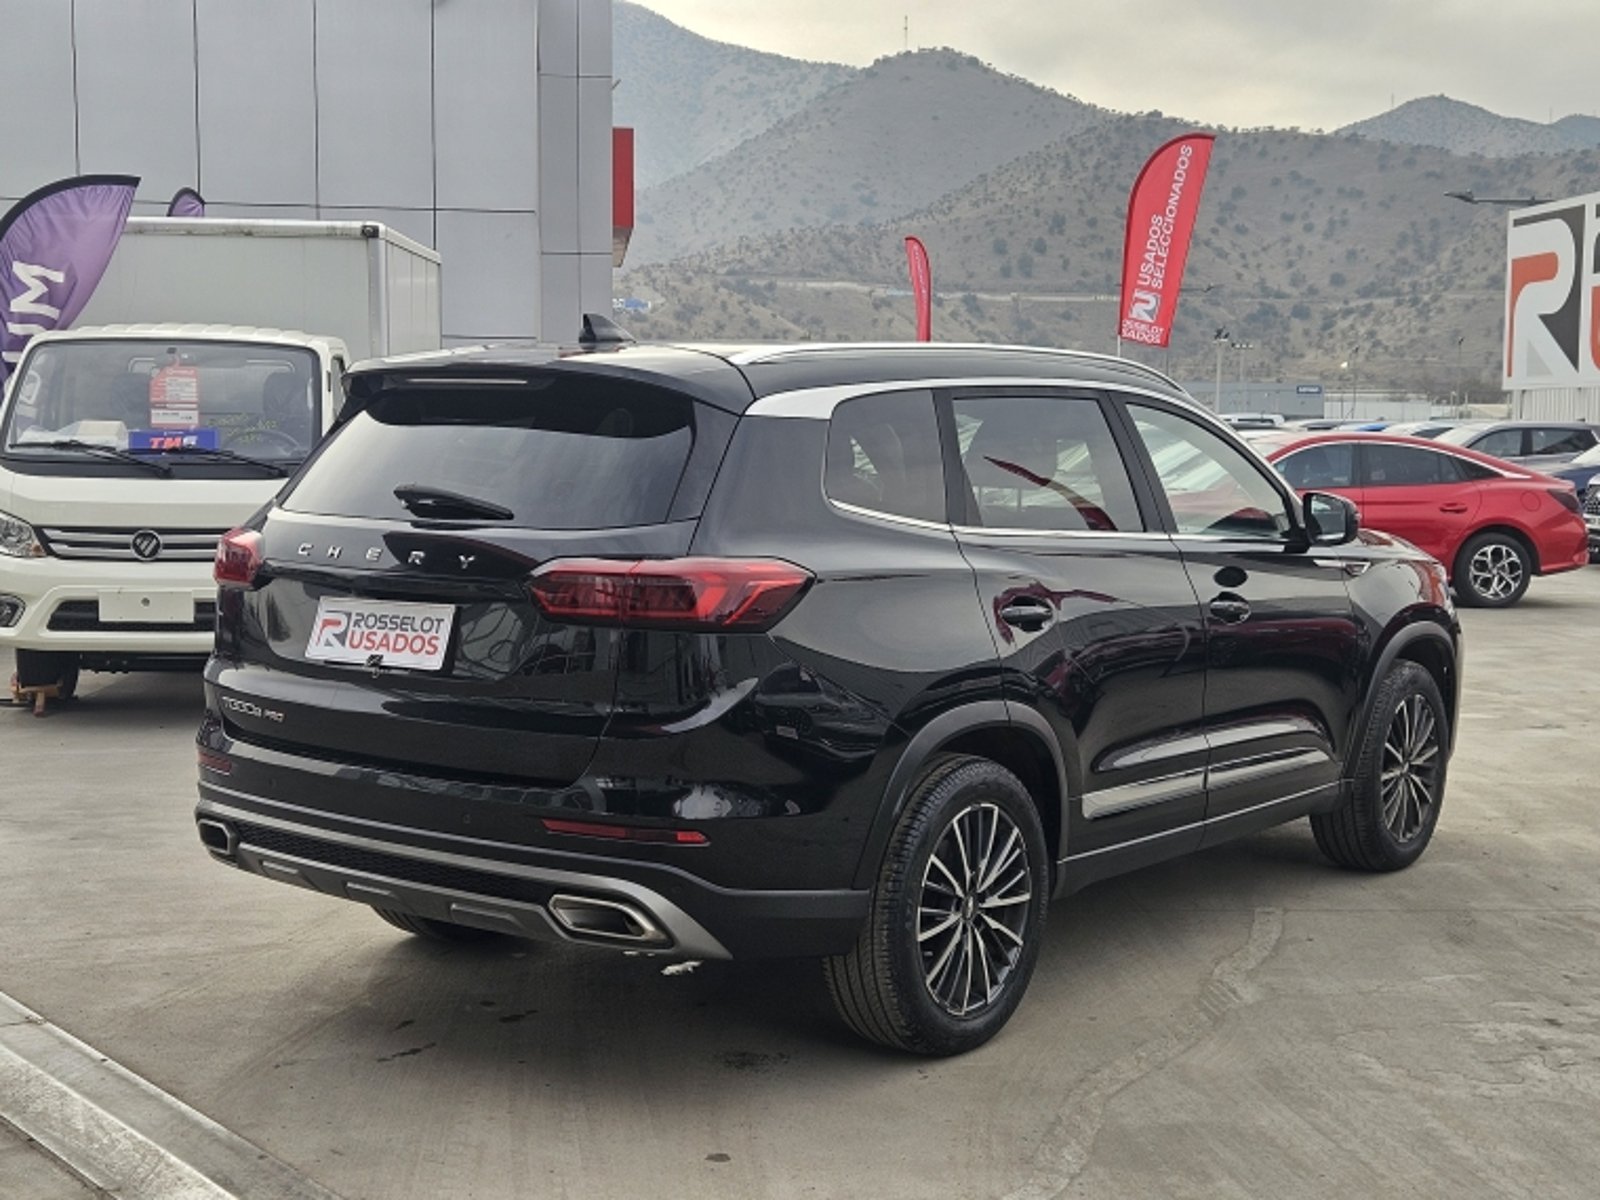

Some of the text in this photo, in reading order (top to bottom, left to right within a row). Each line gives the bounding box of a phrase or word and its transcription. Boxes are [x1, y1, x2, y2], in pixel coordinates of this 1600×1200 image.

[1150, 144, 1194, 289] SELECCIONADOS
[1137, 213, 1164, 286] USADOS
[297, 543, 476, 569] CHERY
[352, 612, 445, 634] ROSSELOT
[349, 631, 441, 655] USADOS
